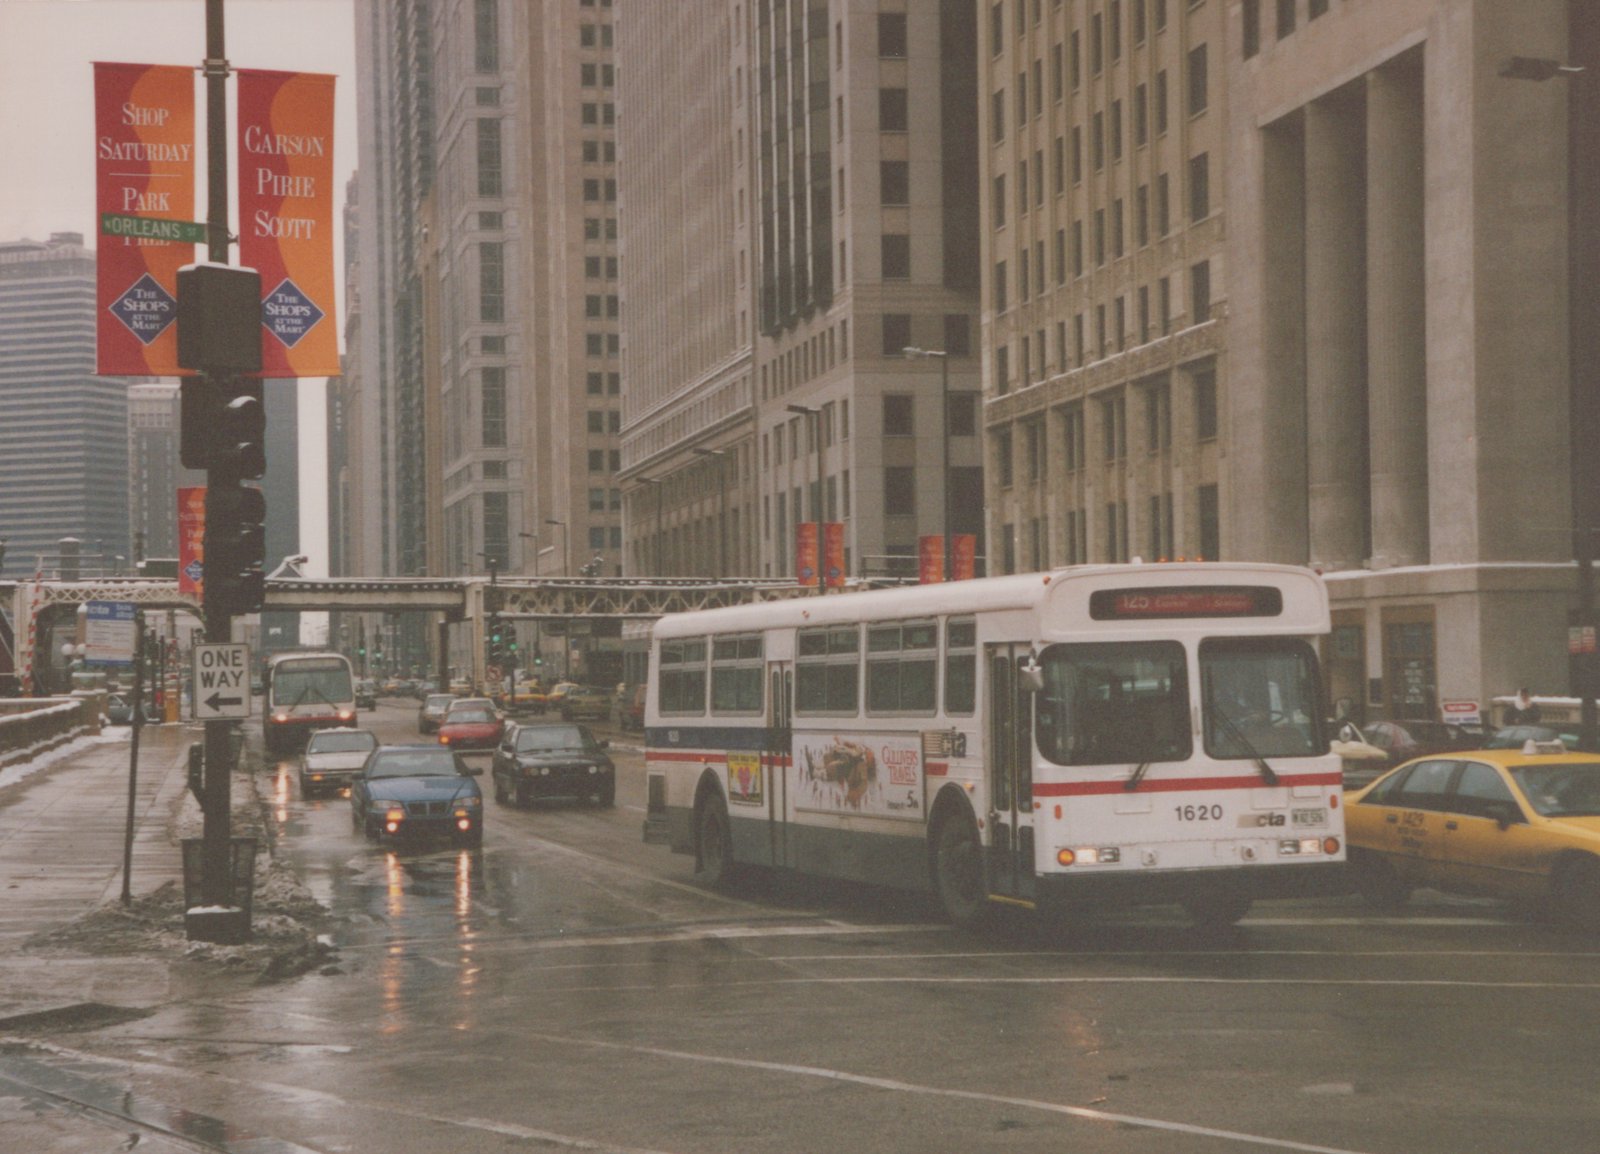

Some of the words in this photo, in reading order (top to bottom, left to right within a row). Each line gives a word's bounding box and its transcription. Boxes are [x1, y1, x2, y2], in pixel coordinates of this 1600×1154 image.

[122, 102, 168, 126] SHOP
[99, 136, 192, 161] SATURDAY
[244, 125, 324, 157] CARSON
[256, 167, 315, 198] PIRIE
[122, 186, 170, 212] PARK
[111, 216, 181, 239] ORLEANS
[255, 209, 316, 240] SCOTT
[133, 288, 157, 299] THE
[274, 292, 299, 304] THE
[123, 298, 170, 312] SHOPS
[265, 302, 312, 317] SHOPS
[201, 650, 243, 668] ONE
[201, 670, 244, 689] WAY
[1175, 804, 1224, 822] 1620
[1256, 812, 1286, 828] cta
